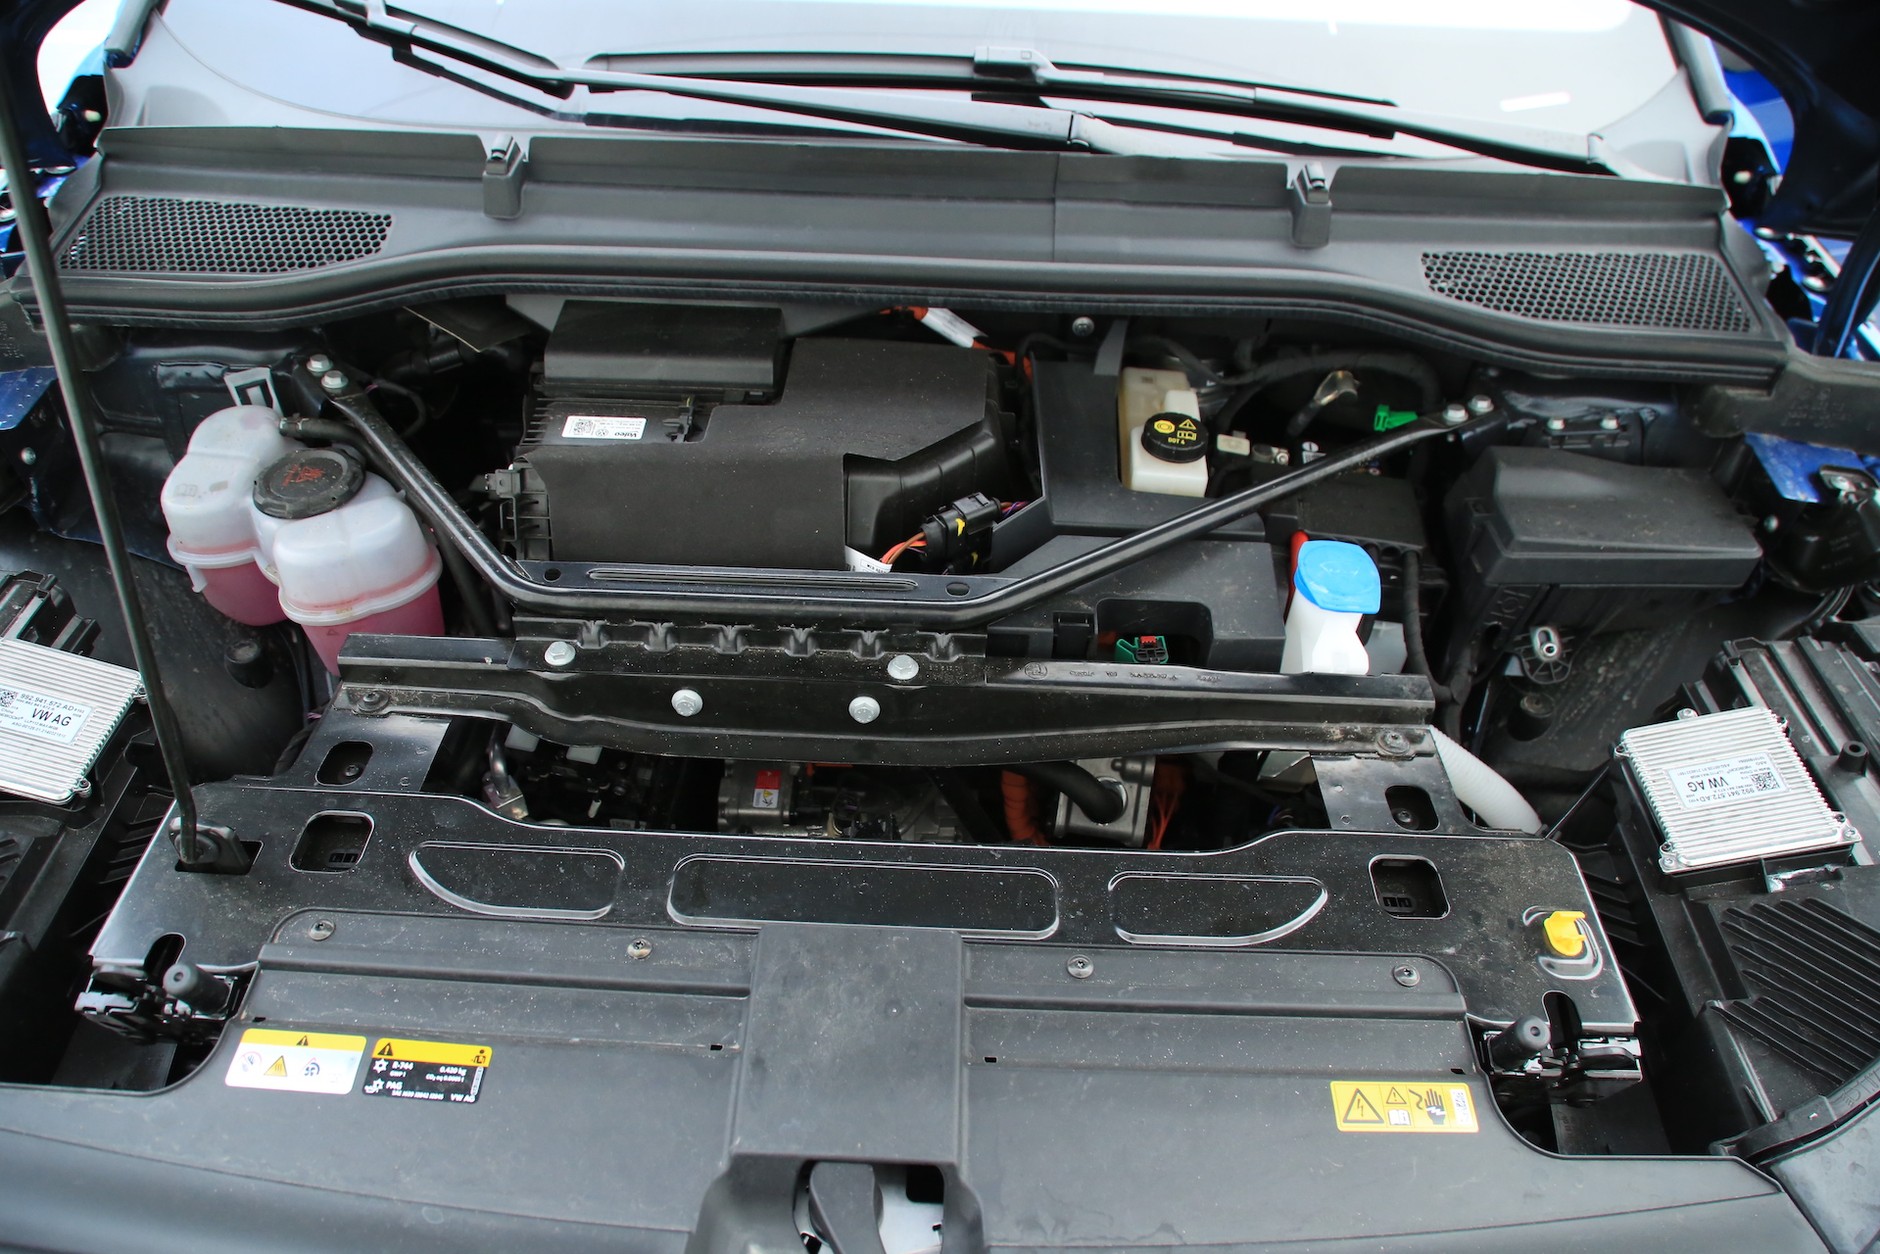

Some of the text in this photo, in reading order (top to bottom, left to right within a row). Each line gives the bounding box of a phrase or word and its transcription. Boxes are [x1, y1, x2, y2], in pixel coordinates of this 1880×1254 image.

[32, 708, 53, 721] VW
[51, 714, 72, 727] AG
[1687, 780, 1705, 792] AG
[1708, 776, 1729, 789] VW
[391, 1061, 414, 1070] R-744
[458, 1067, 467, 1076] kg
[385, 1080, 403, 1090] PAG
[450, 1093, 476, 1103] VW AG
